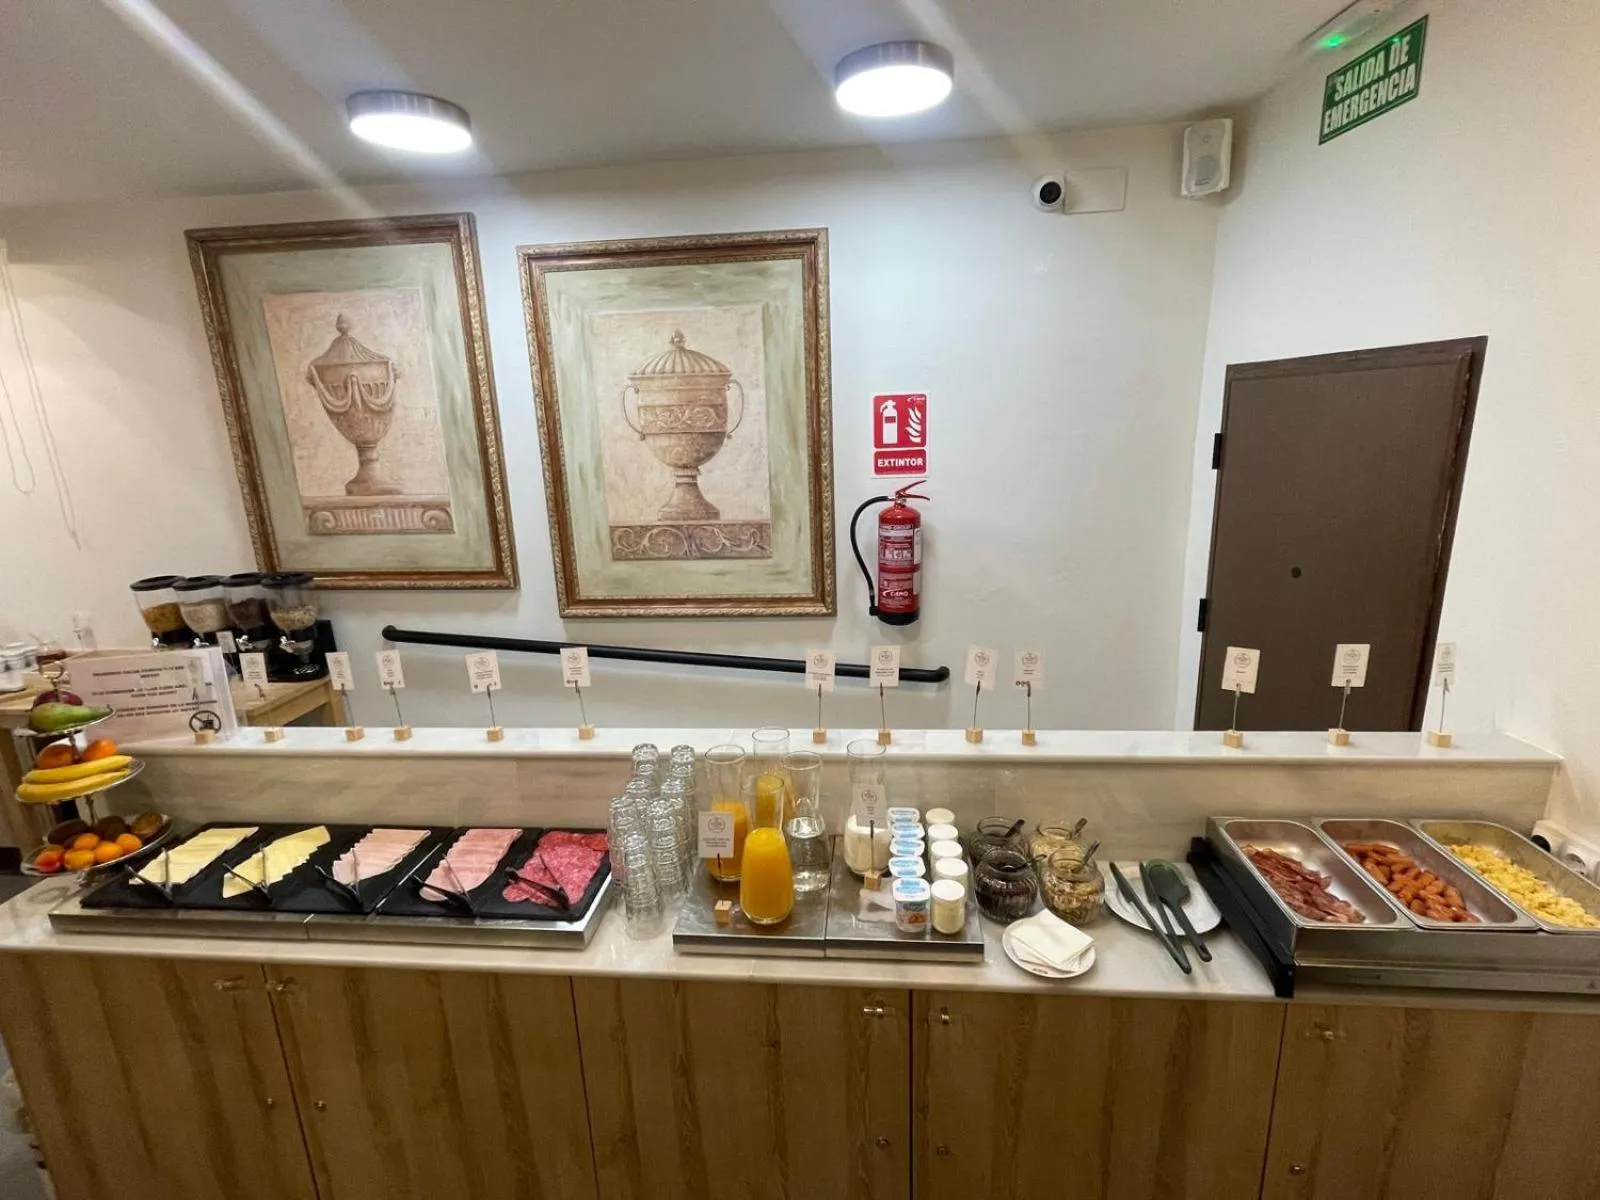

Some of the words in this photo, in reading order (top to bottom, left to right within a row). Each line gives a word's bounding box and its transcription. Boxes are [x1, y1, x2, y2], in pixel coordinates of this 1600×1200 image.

[1323, 63, 1416, 134] EMERGENCIA
[1334, 50, 1385, 101] SALIDA
[1388, 34, 1411, 71] DE
[877, 458, 924, 467] EXTINTOR
